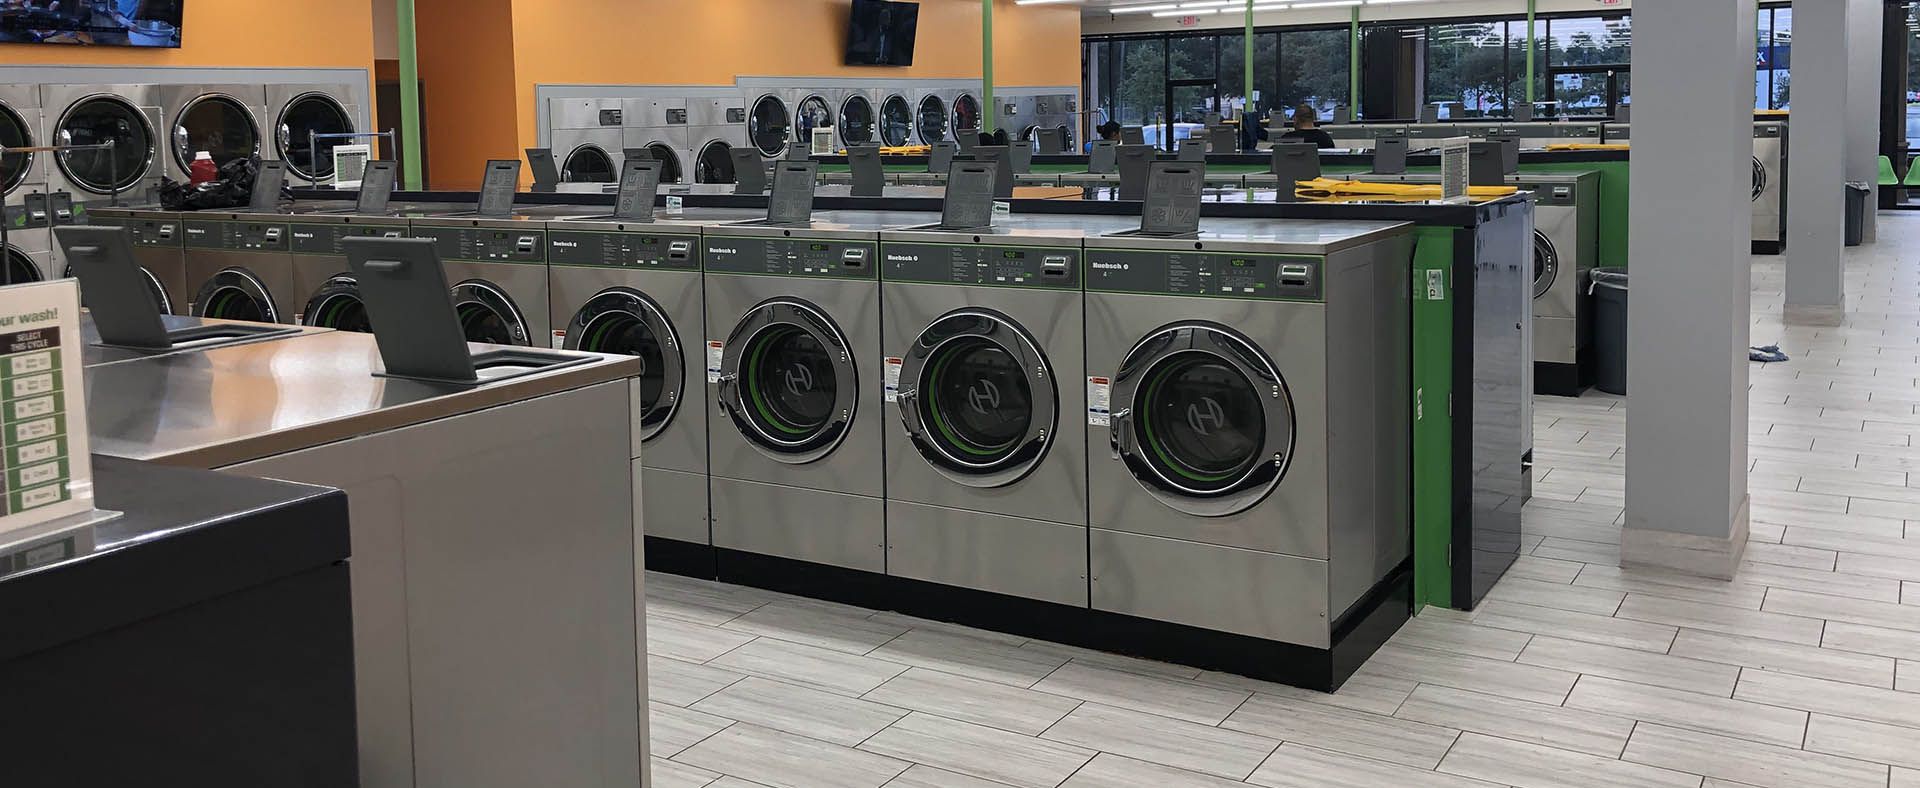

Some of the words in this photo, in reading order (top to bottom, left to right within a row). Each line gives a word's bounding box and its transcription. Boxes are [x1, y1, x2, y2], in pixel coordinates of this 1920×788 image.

[19, 307, 58, 324] wash!
[16, 331, 42, 342] SELECT
[27, 339, 49, 349] CYCLE
